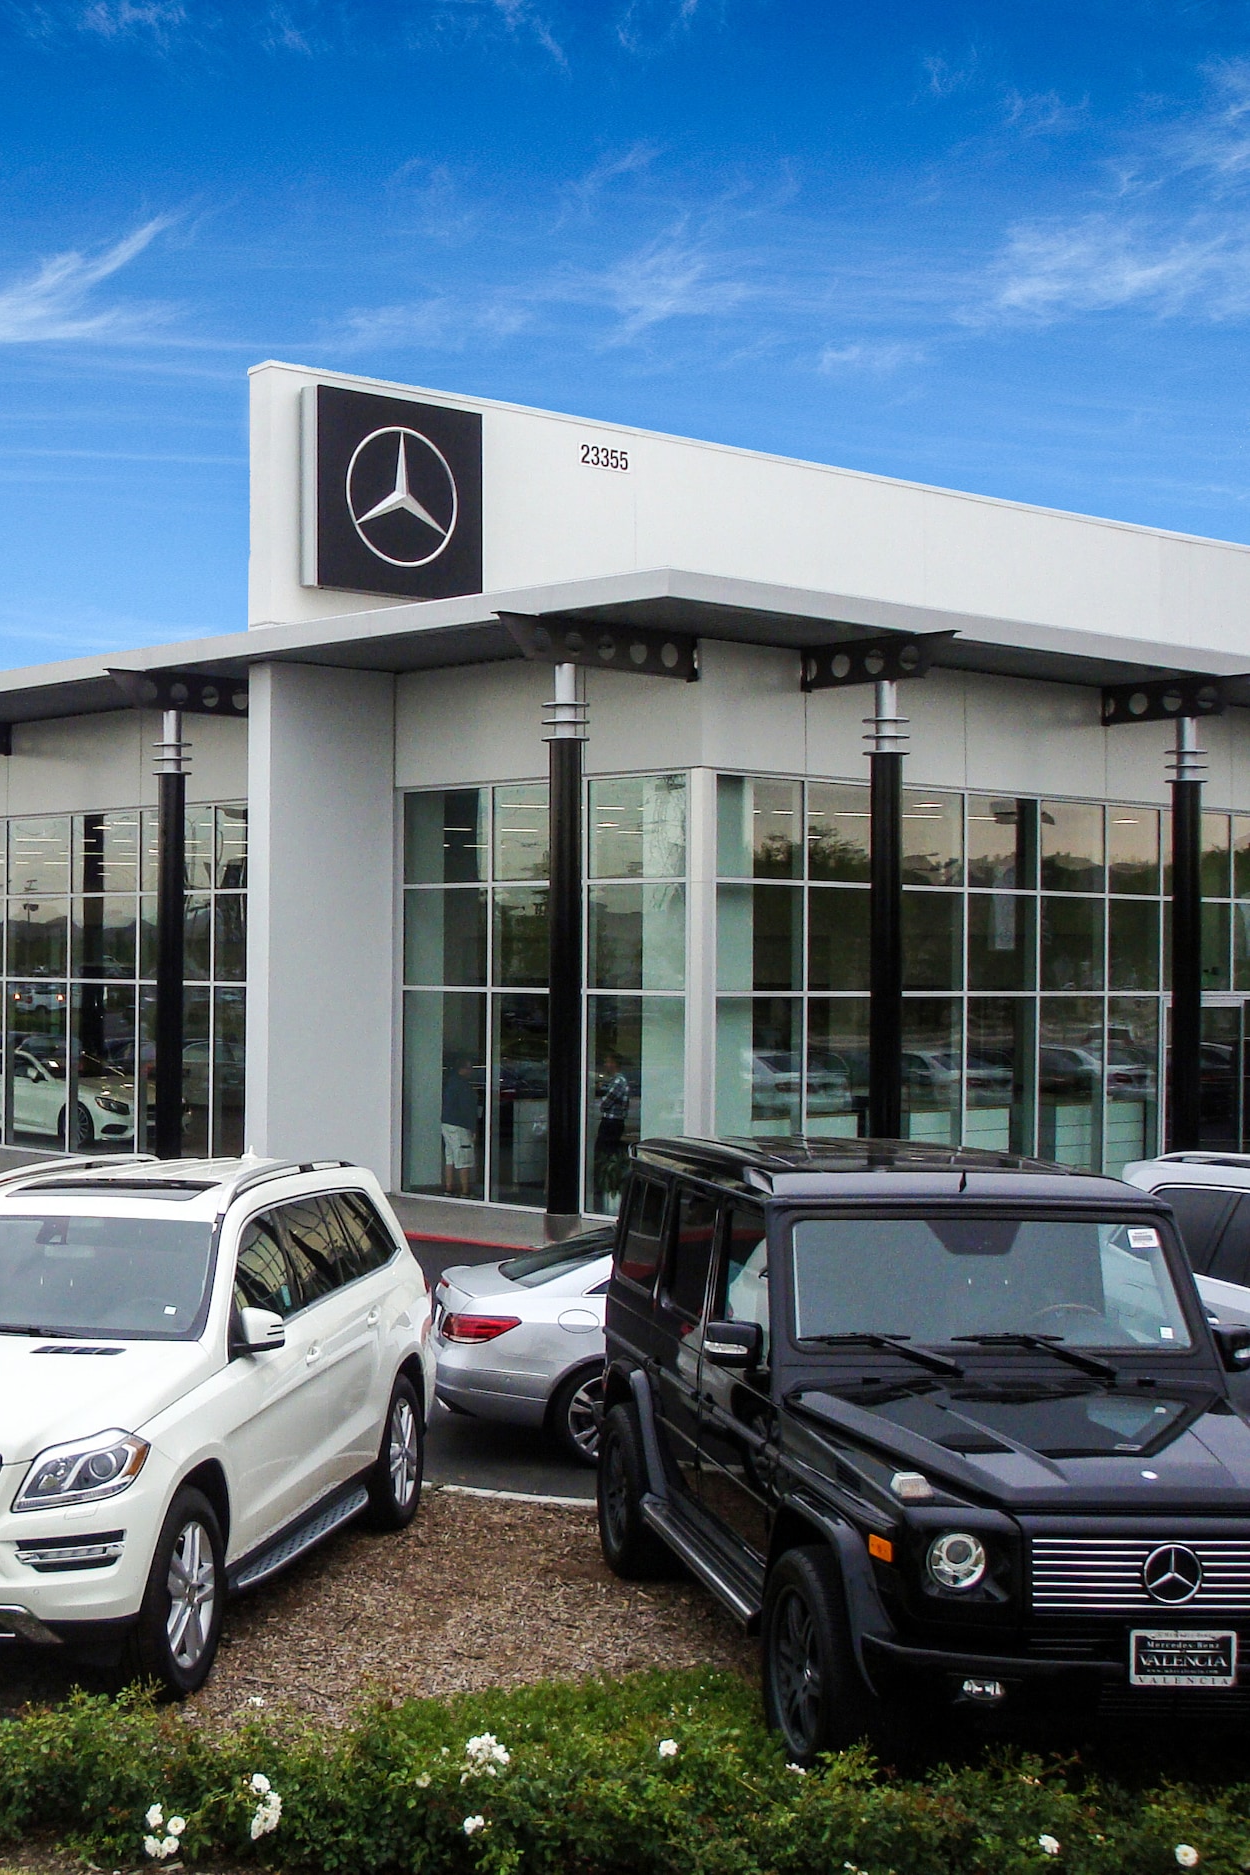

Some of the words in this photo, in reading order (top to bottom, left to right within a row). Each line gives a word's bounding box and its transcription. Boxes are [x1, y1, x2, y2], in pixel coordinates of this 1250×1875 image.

[580, 444, 629, 471] 23355
[1138, 1653, 1228, 1667] VALENCIA
[1138, 1676, 1229, 1685] VALENCIA
